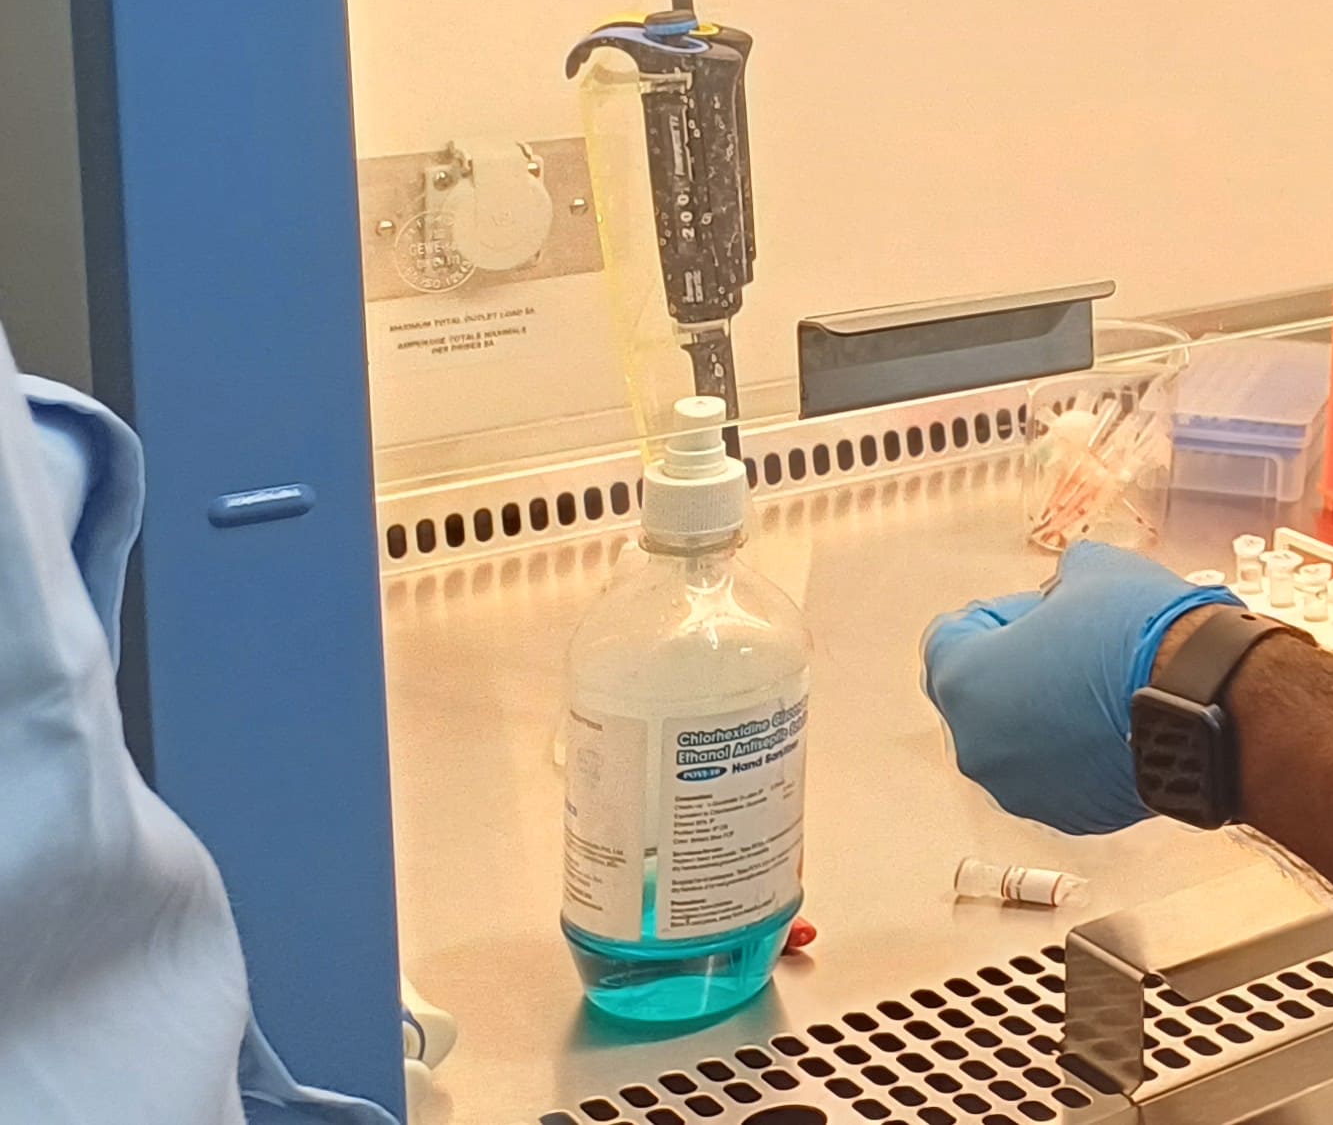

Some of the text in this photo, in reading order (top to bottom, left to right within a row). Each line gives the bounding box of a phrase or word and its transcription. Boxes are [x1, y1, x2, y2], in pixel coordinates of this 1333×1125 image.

[434, 317, 461, 328] TOTAL
[677, 719, 770, 747] Chlorhexidine
[677, 727, 788, 766] Ethanol Antiseptic
[732, 757, 763, 774] Hand
